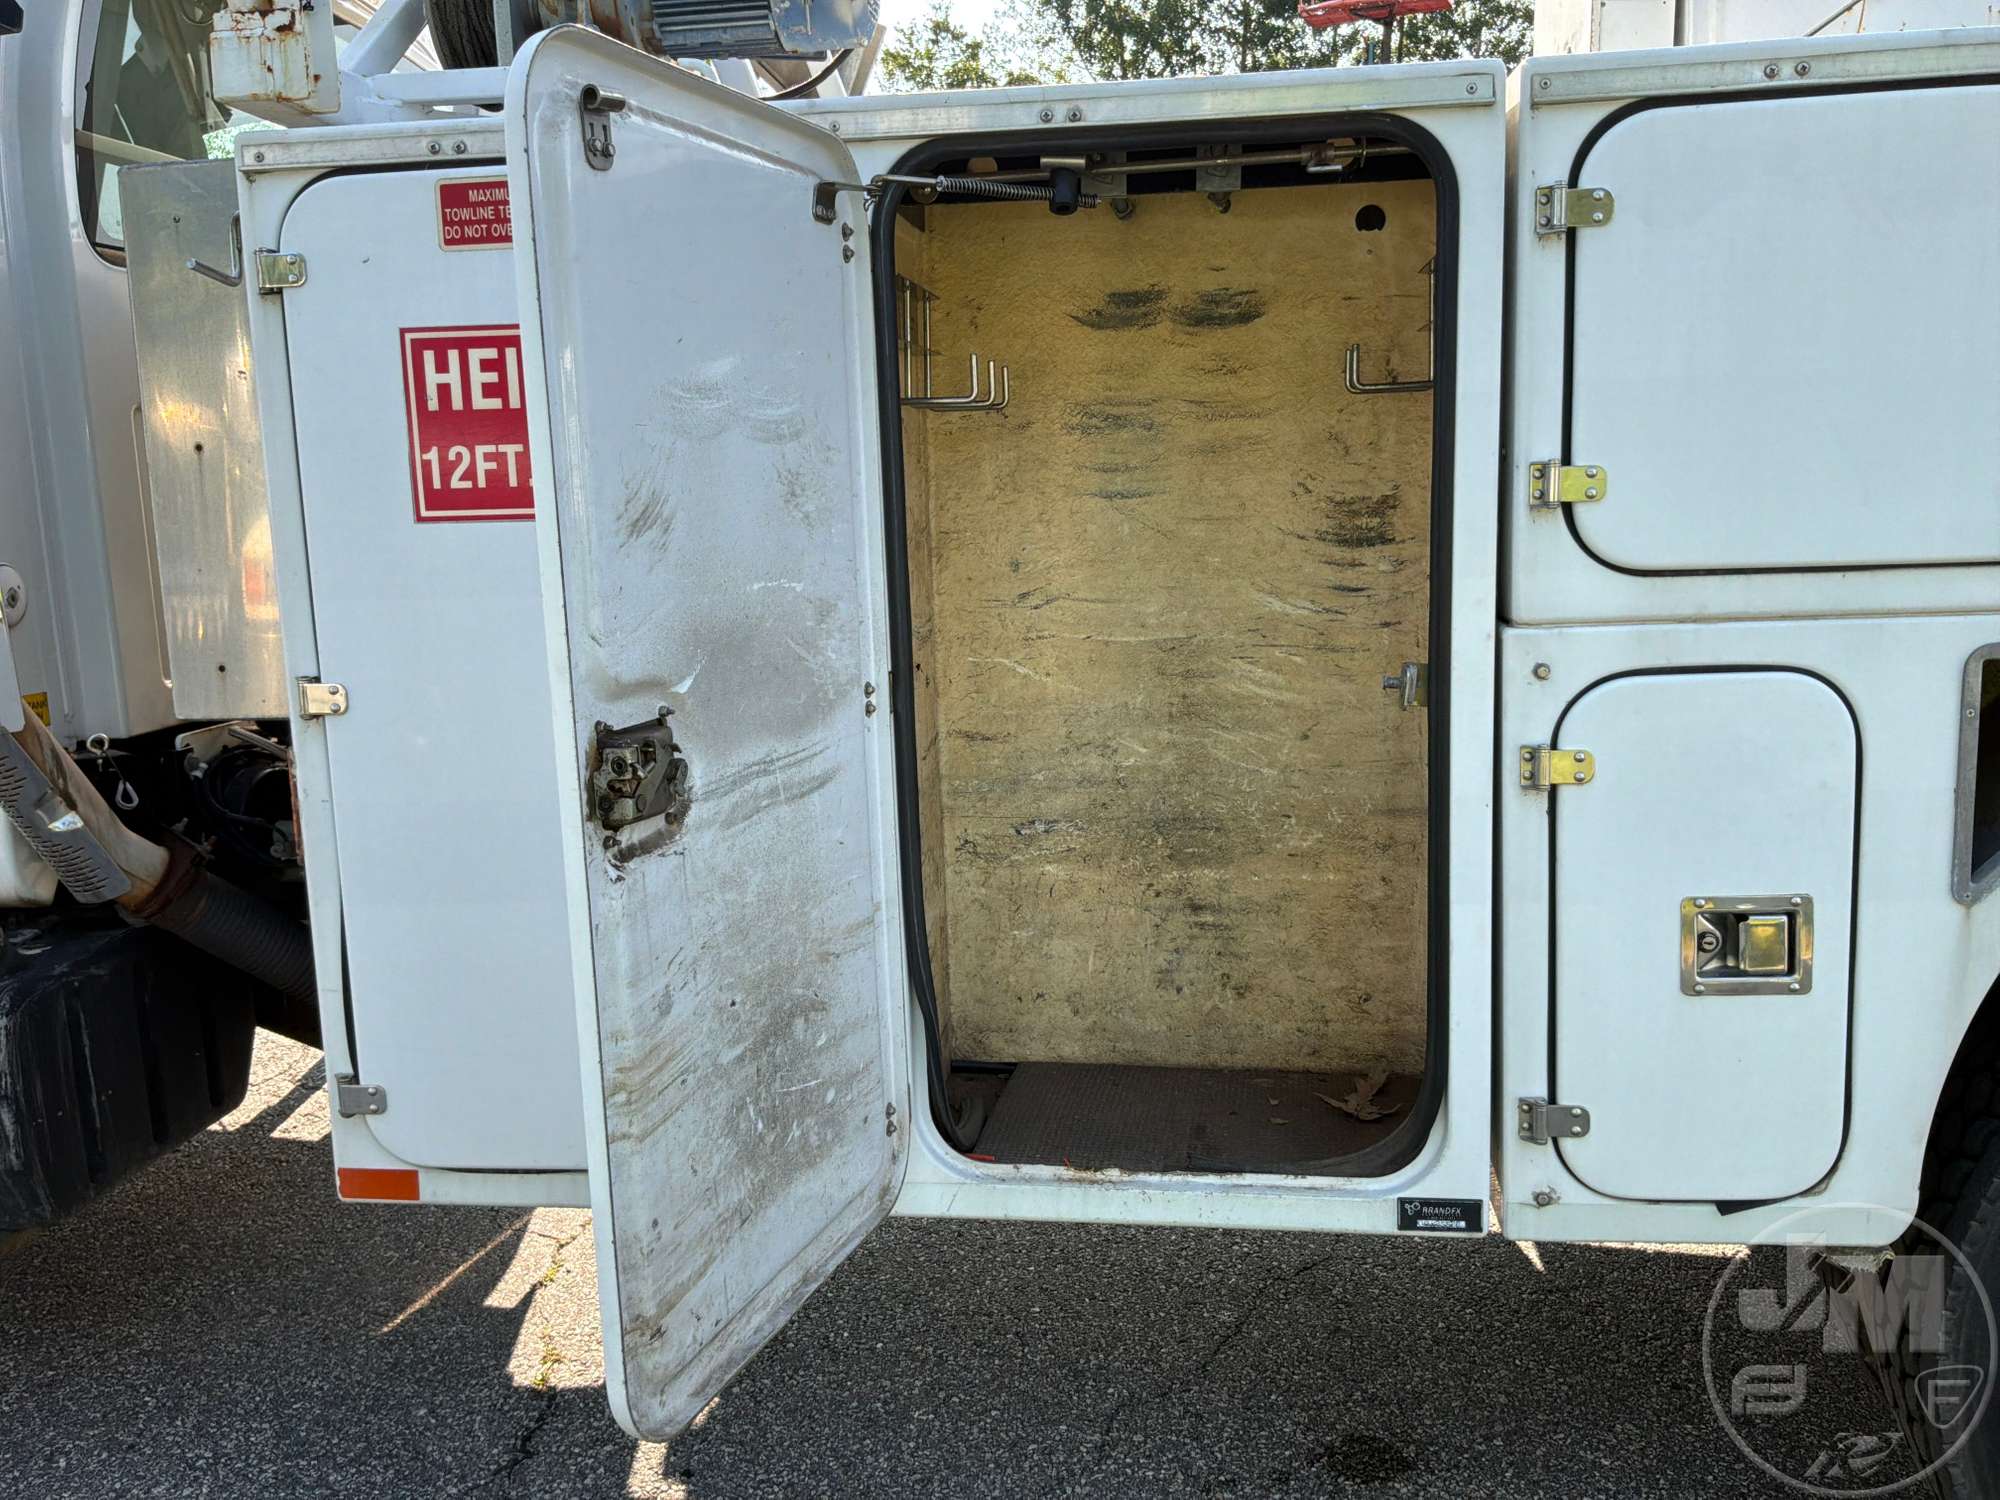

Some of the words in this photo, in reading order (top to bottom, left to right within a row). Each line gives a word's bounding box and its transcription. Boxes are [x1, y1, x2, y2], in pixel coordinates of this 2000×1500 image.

[444, 206, 496, 222] TOWLINE
[444, 225, 462, 240] DO
[464, 224, 488, 238] NOT
[423, 347, 521, 412] HEI
